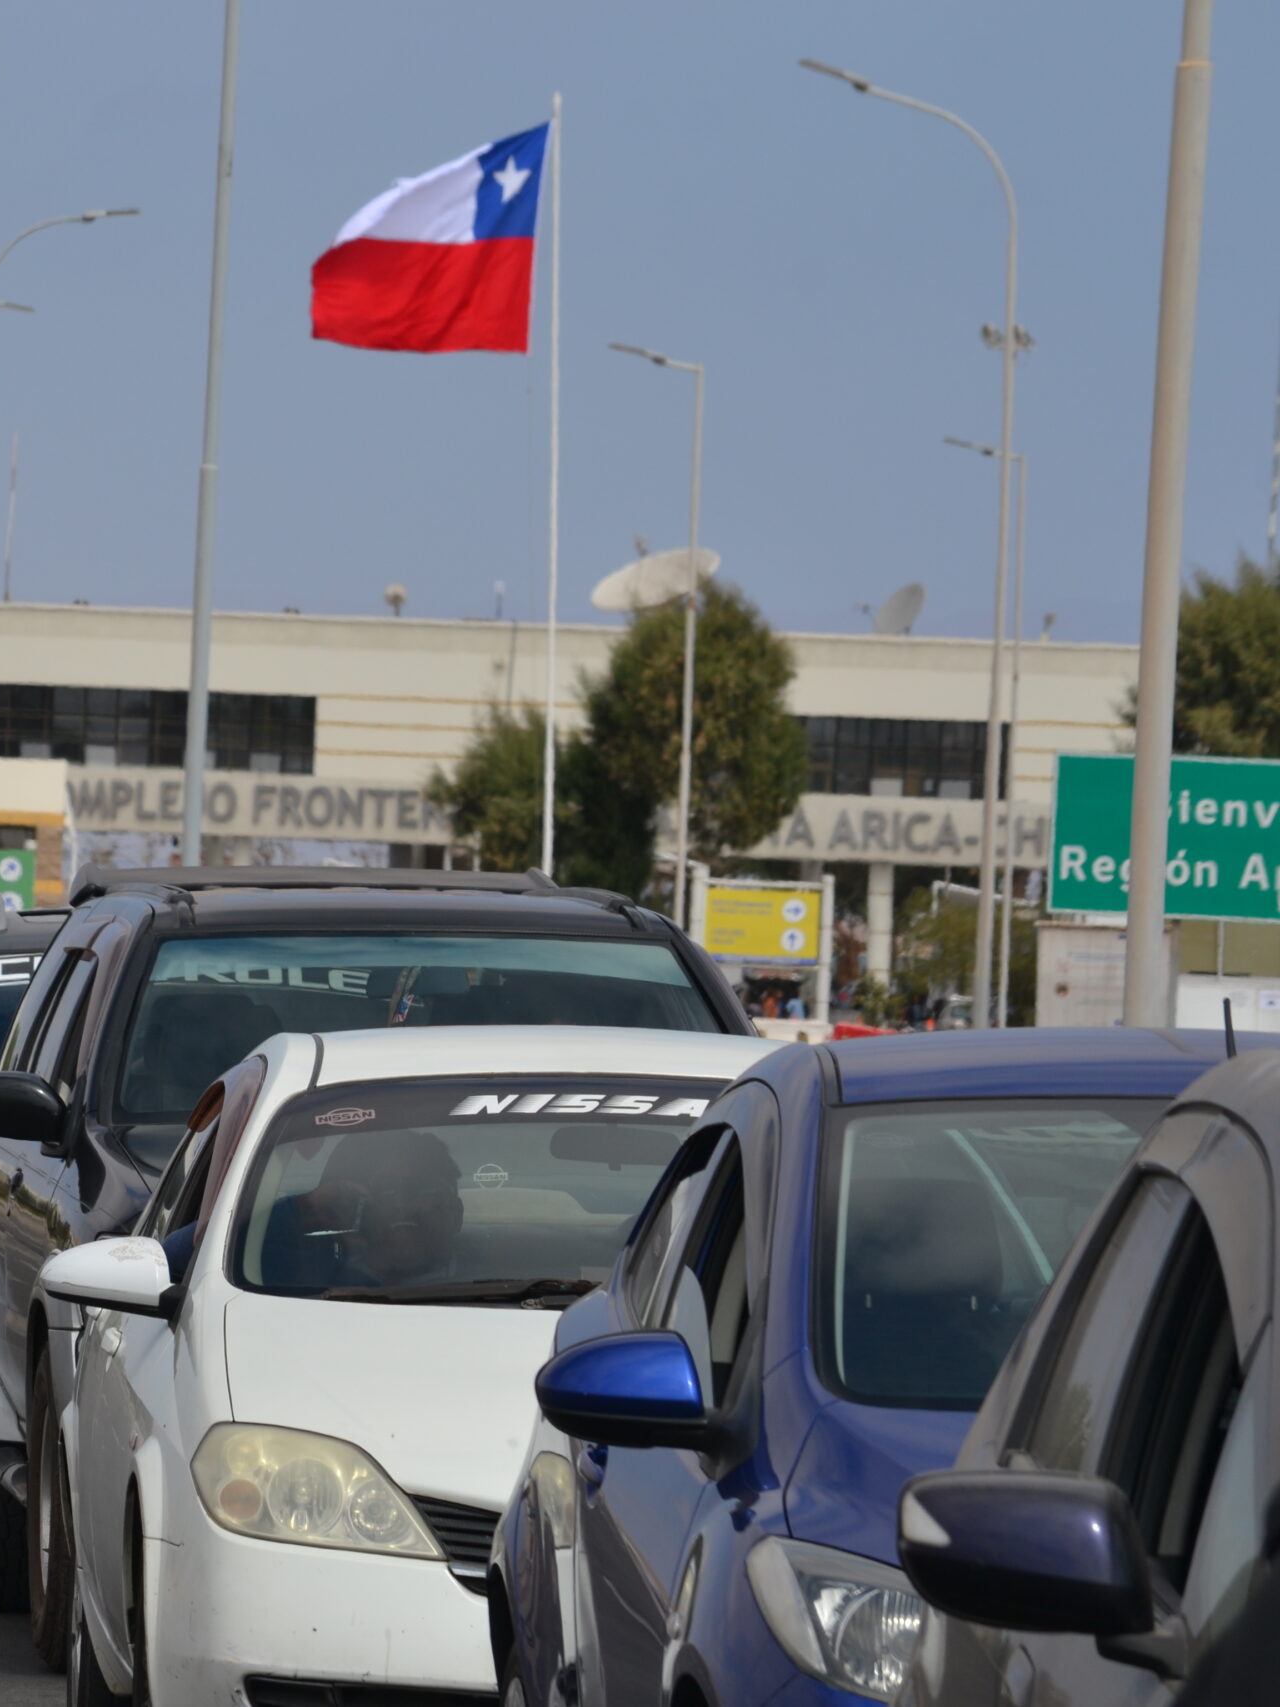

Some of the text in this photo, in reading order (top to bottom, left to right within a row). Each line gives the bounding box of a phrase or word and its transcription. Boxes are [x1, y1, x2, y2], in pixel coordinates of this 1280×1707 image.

[66, 778, 238, 824] MPLEO
[1168, 789, 1280, 829] ienv
[1059, 845, 1280, 912] Reón A
[317, 1110, 373, 1124] NISSAN
